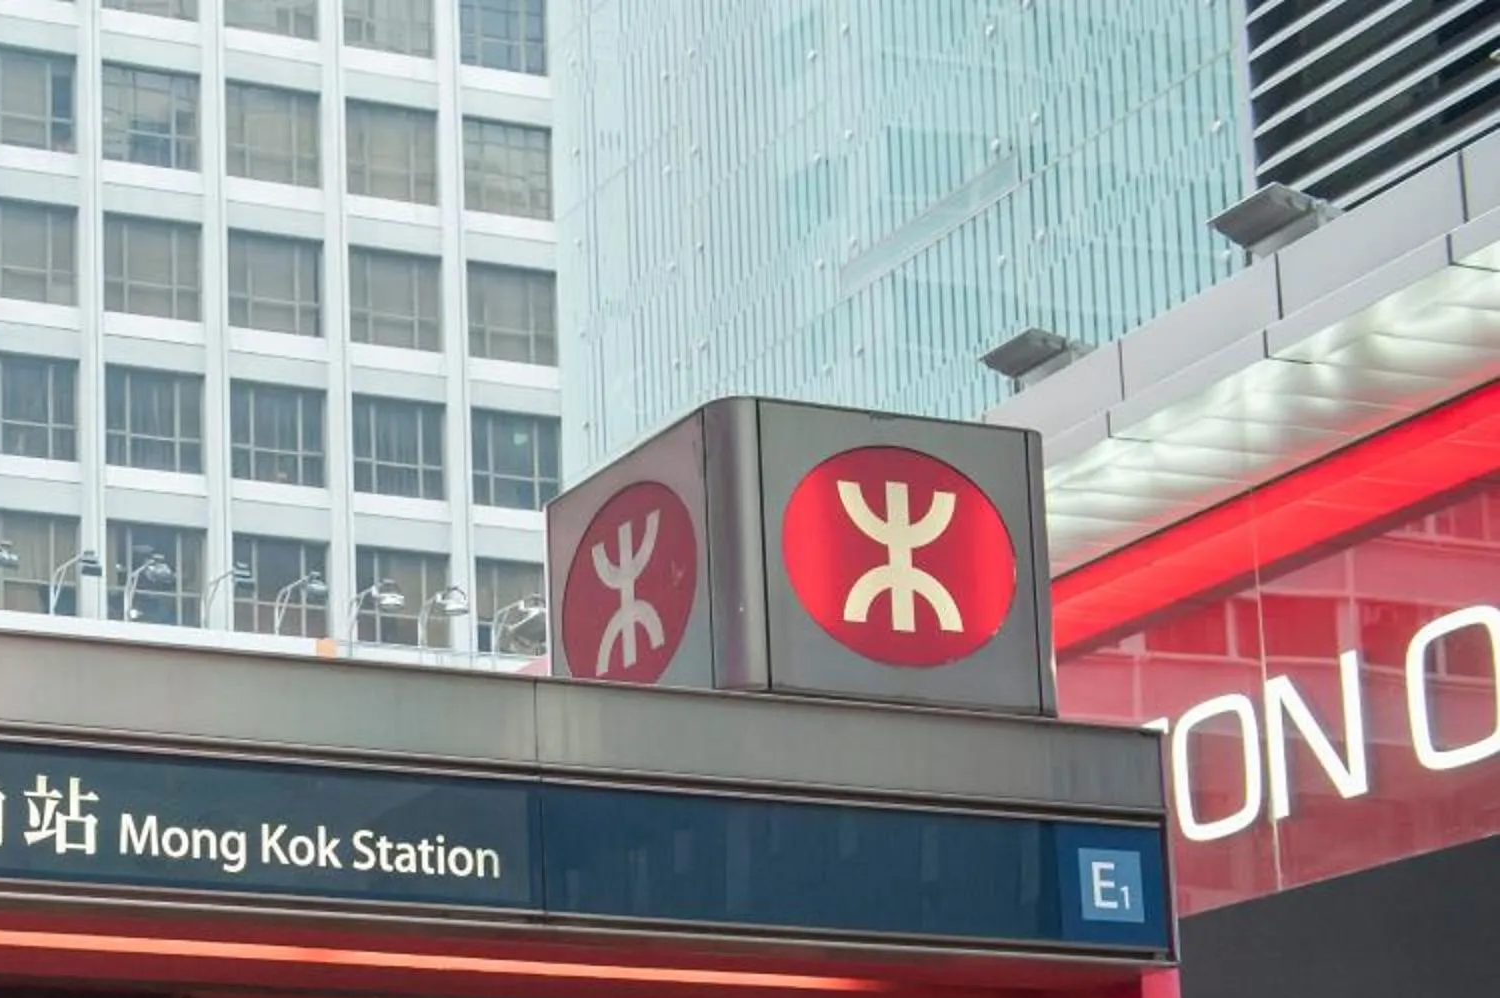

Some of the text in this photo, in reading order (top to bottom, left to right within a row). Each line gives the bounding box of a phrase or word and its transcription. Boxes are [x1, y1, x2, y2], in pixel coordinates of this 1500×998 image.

[1141, 650, 1368, 842] ON
[119, 813, 500, 879] Mong Kok Station
